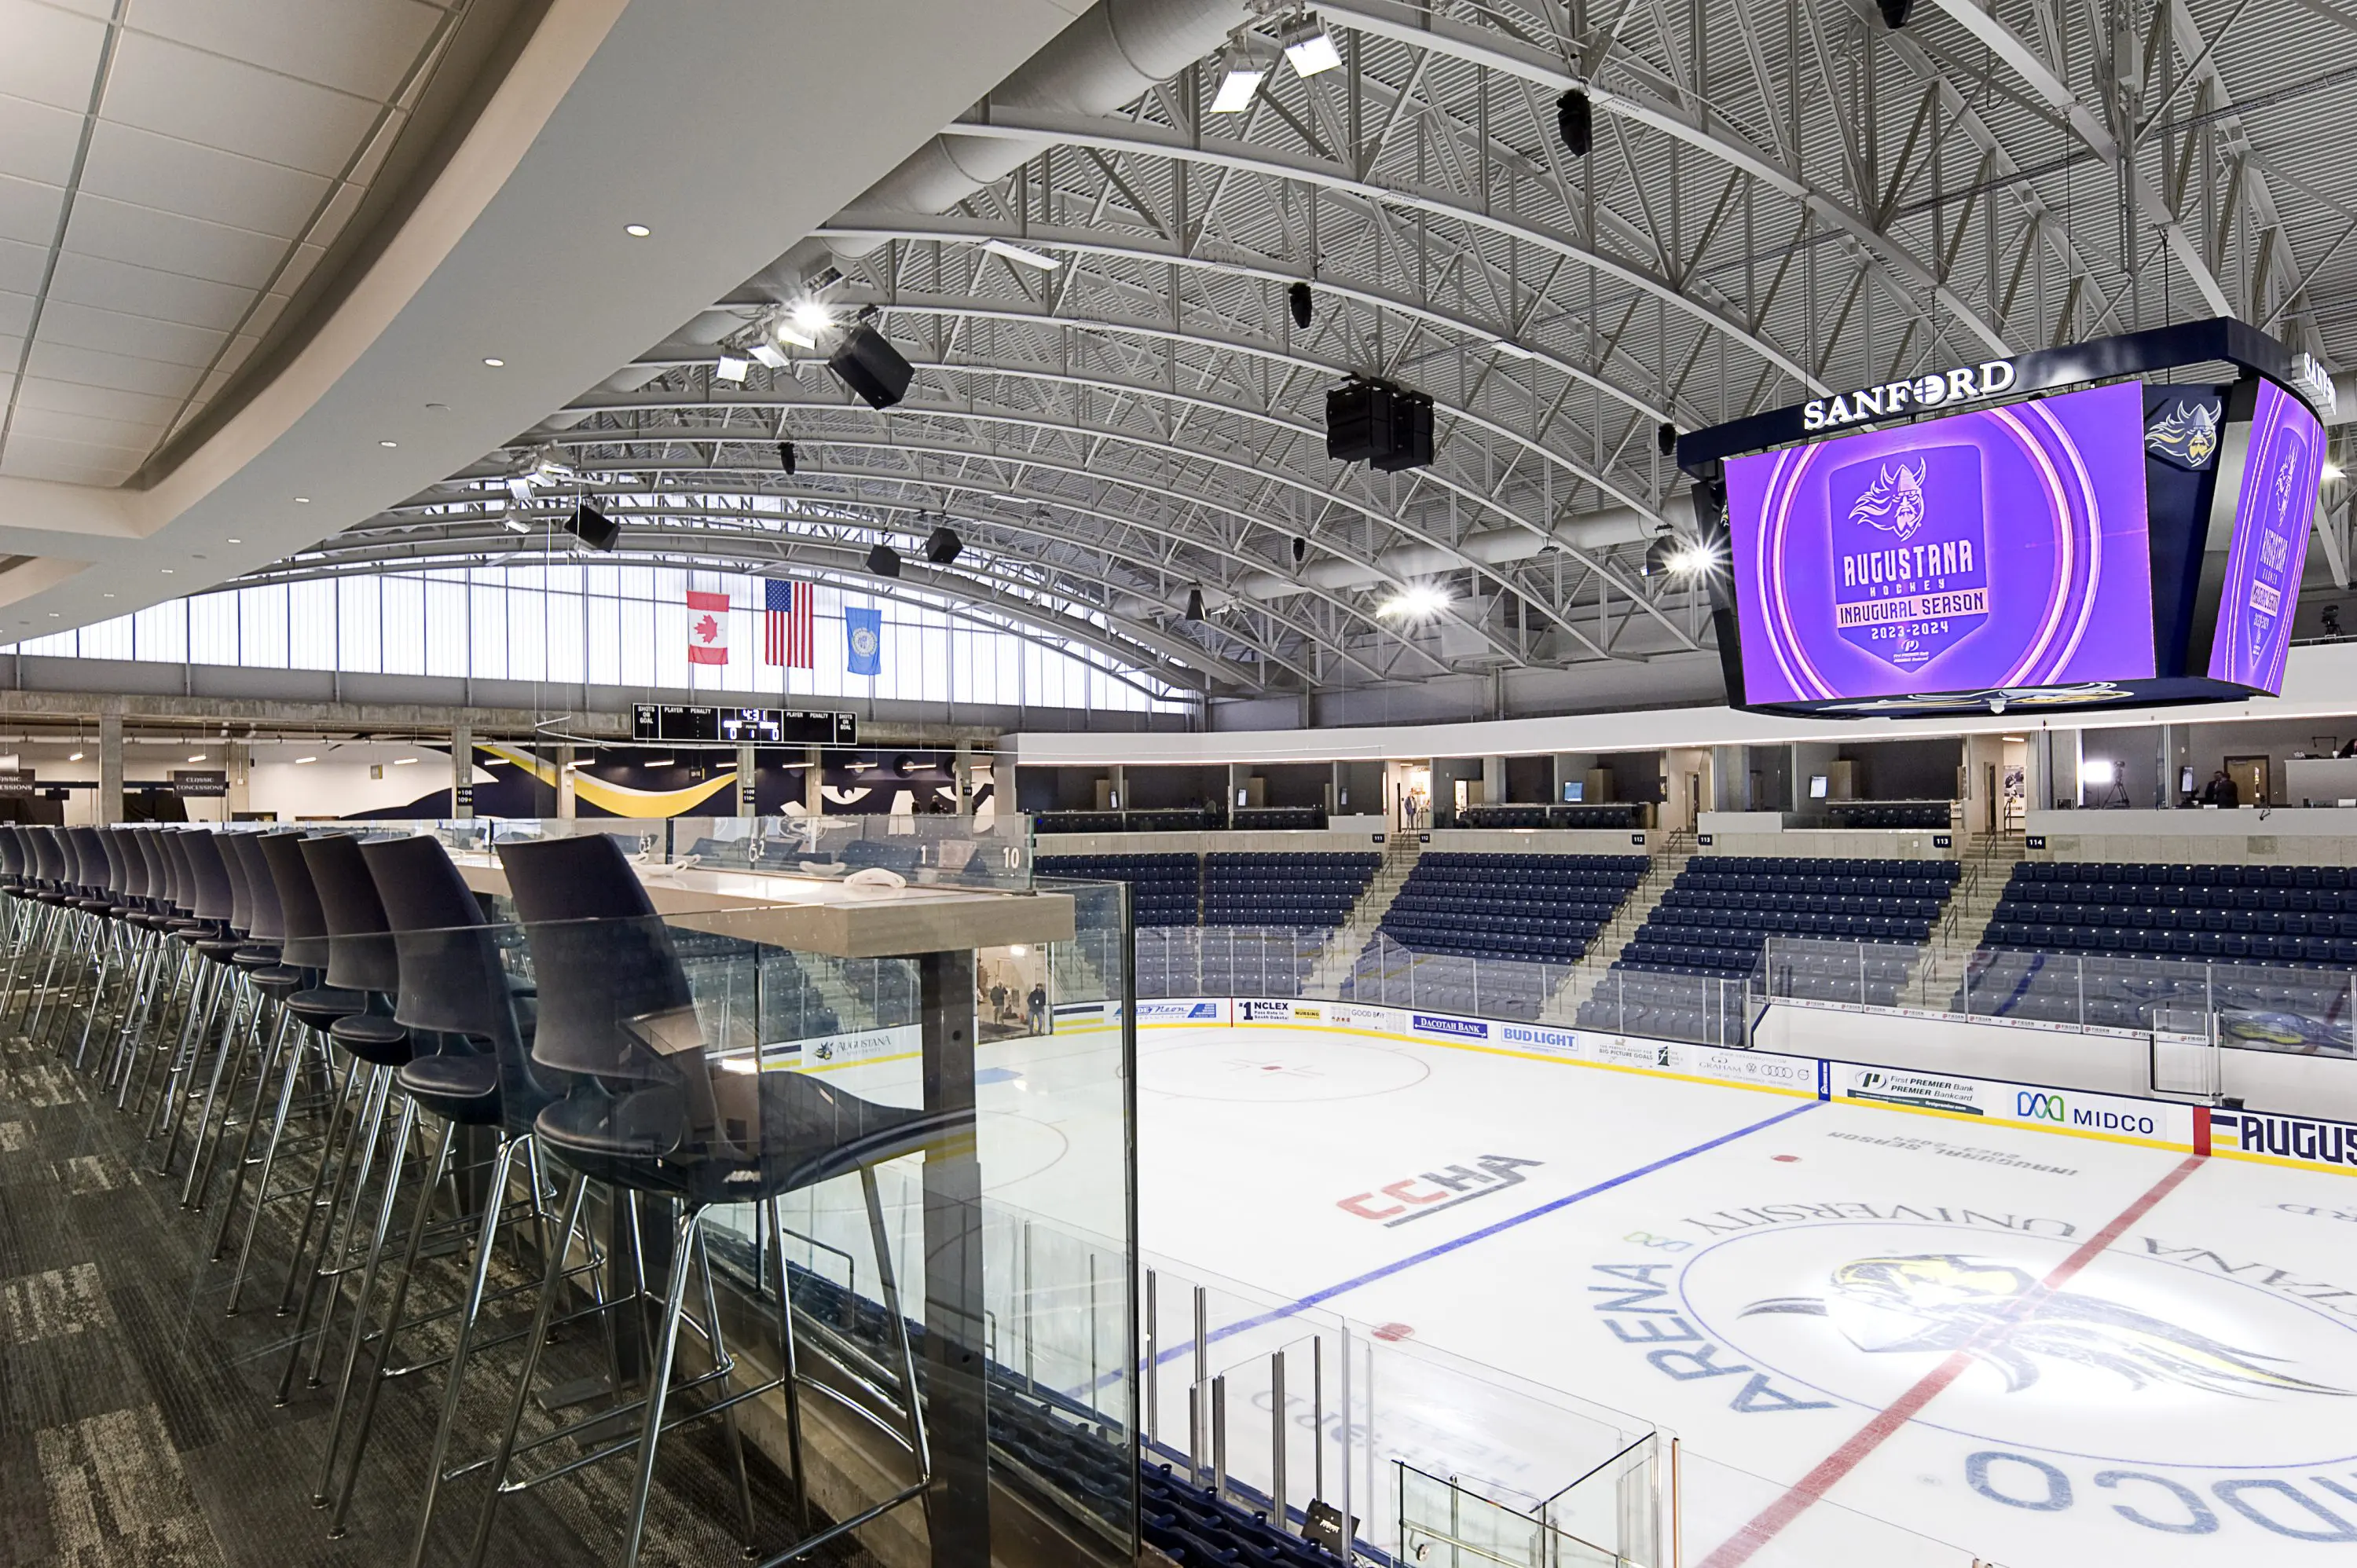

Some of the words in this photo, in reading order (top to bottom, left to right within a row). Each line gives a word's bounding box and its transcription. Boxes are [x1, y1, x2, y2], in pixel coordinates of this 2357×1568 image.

[1804, 360, 2015, 430] SANFORD
[1843, 539, 1974, 587] AUGUSTANA
[1870, 578, 1945, 598] HOCKEY
[1840, 599, 1917, 625] INAUGURAL
[1922, 592, 1984, 615] SEASON
[1871, 621, 1949, 640] 2023-2024
[1003, 847, 1020, 869] 10
[1254, 1002, 1288, 1010] NCLEX
[1351, 1009, 1372, 1017] GOOD
[1420, 1017, 1457, 1030] DACOTAH
[1457, 1022, 1480, 1033] BANK
[836, 1035, 892, 1053] AUGUSTANA
[1504, 1028, 1532, 1042] BUD
[1534, 1031, 1575, 1047] LIGHT
[1699, 1061, 1742, 1073] GRAHAM
[1890, 1075, 1908, 1085] First
[1909, 1078, 1952, 1090] PREMIER
[1953, 1083, 1974, 1092] Bank
[1890, 1085, 1932, 1096] PREMIER
[1933, 1090, 1973, 1101] Bankcard
[2073, 1108, 2154, 1135] MIDCO
[1336, 1154, 1546, 1222] CCHA
[1679, 1202, 2080, 1239] UNIVERSITY
[1586, 1262, 1840, 1414] ARENA
